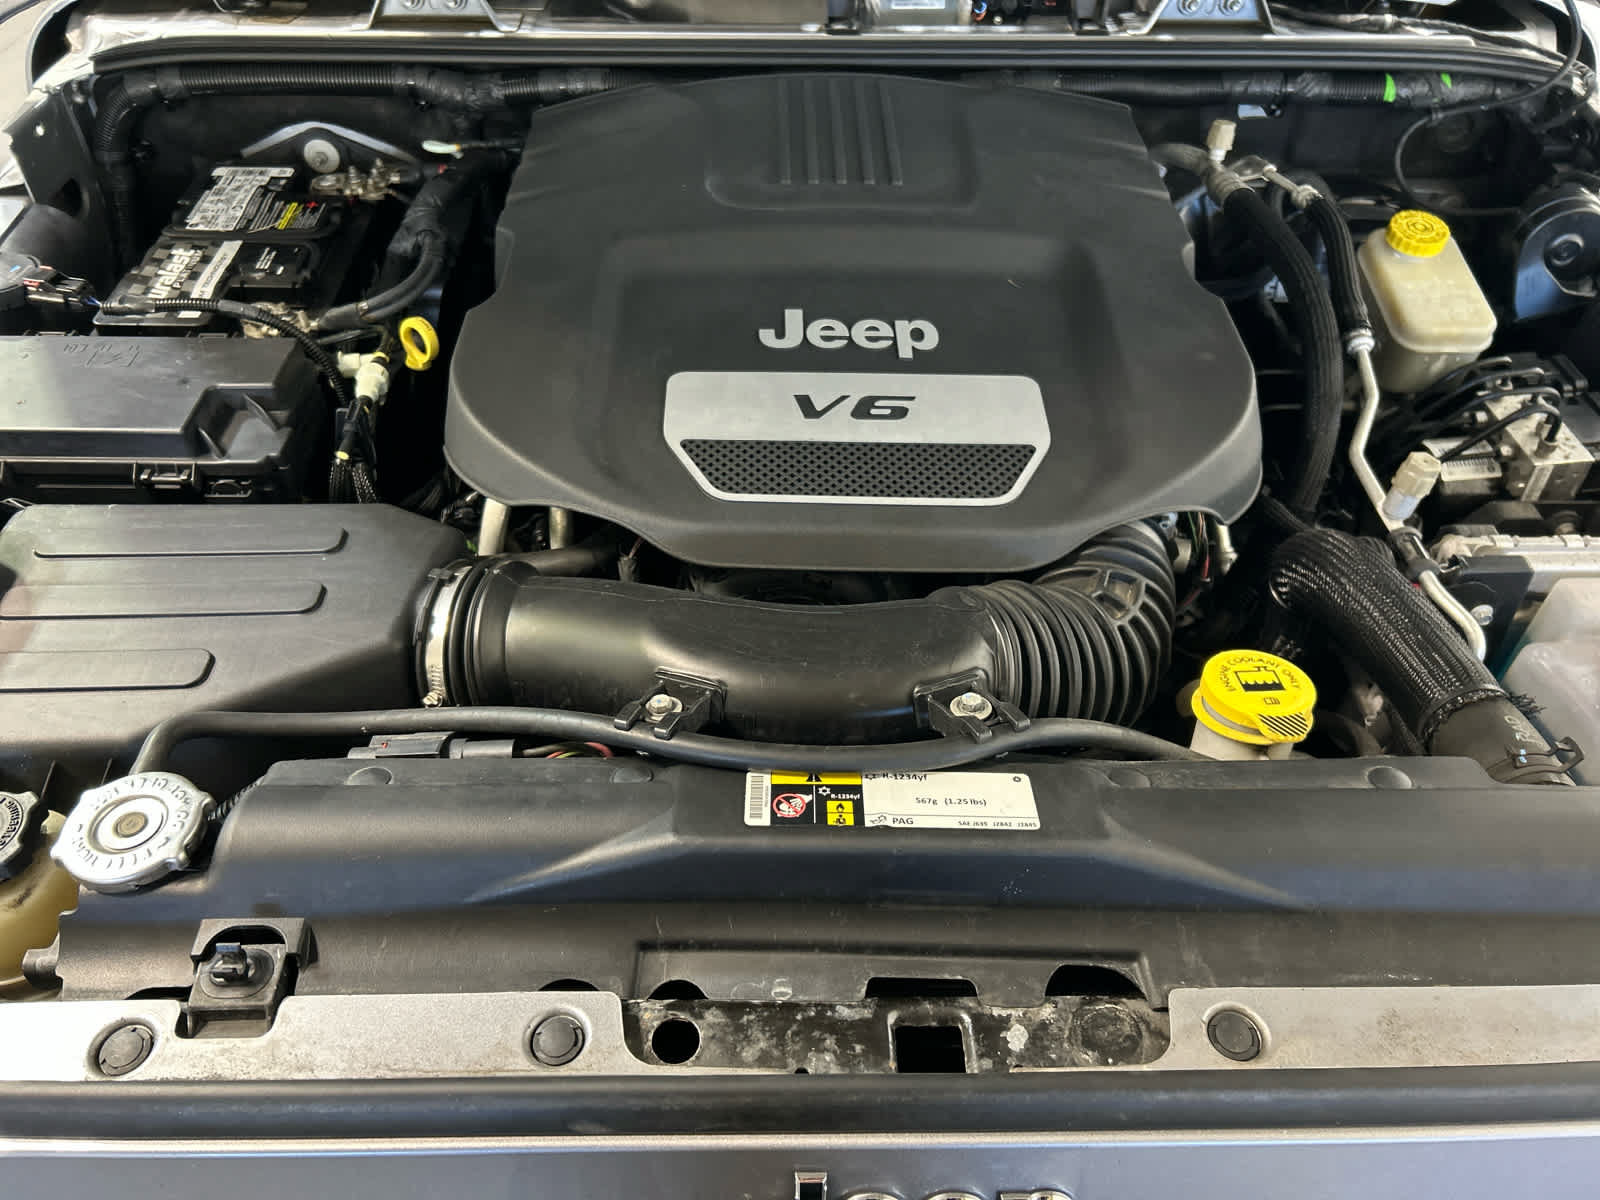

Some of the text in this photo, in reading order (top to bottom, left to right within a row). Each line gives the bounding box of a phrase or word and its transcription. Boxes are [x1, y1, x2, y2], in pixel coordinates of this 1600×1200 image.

[148, 248, 195, 298] uralast
[758, 308, 940, 359] Jeep
[793, 394, 916, 420] V6
[915, 797, 938, 805] 567g
[944, 797, 968, 806] (1.25
[892, 817, 914, 825] PAG
